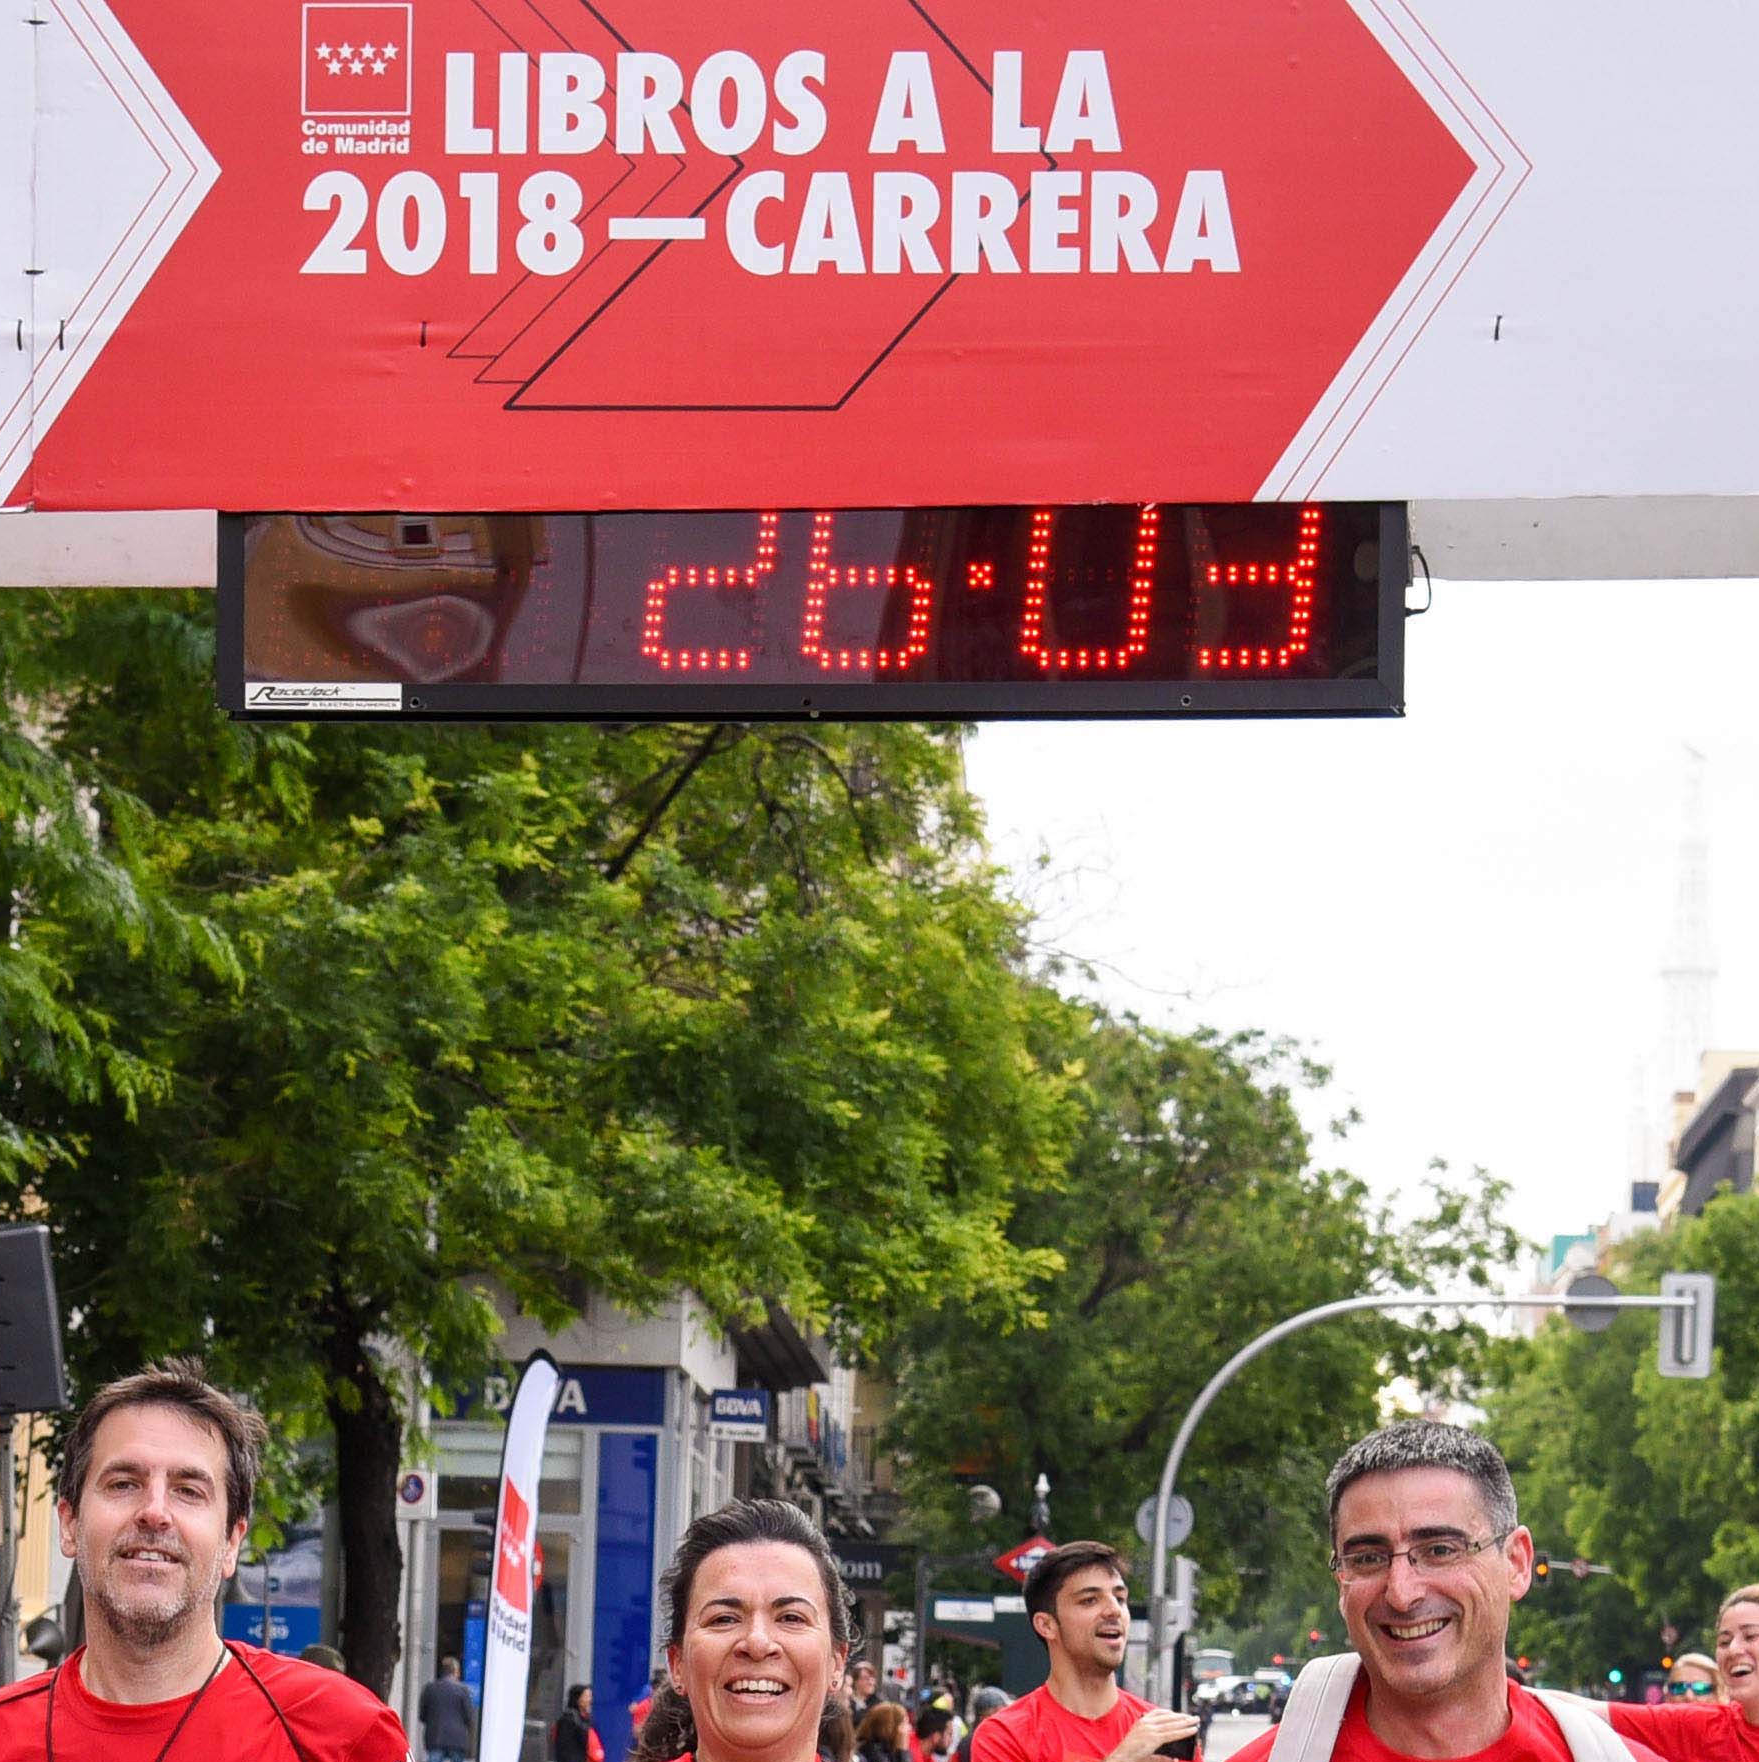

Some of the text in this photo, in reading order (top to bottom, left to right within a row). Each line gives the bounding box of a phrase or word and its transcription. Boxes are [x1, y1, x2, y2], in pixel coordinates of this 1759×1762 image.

[446, 50, 1121, 155] LIBROS A LA
[301, 119, 410, 136] Comunidad
[301, 137, 410, 154] de Madrid
[249, 686, 340, 701] Raceclock
[714, 1396, 763, 1417] BBVA
